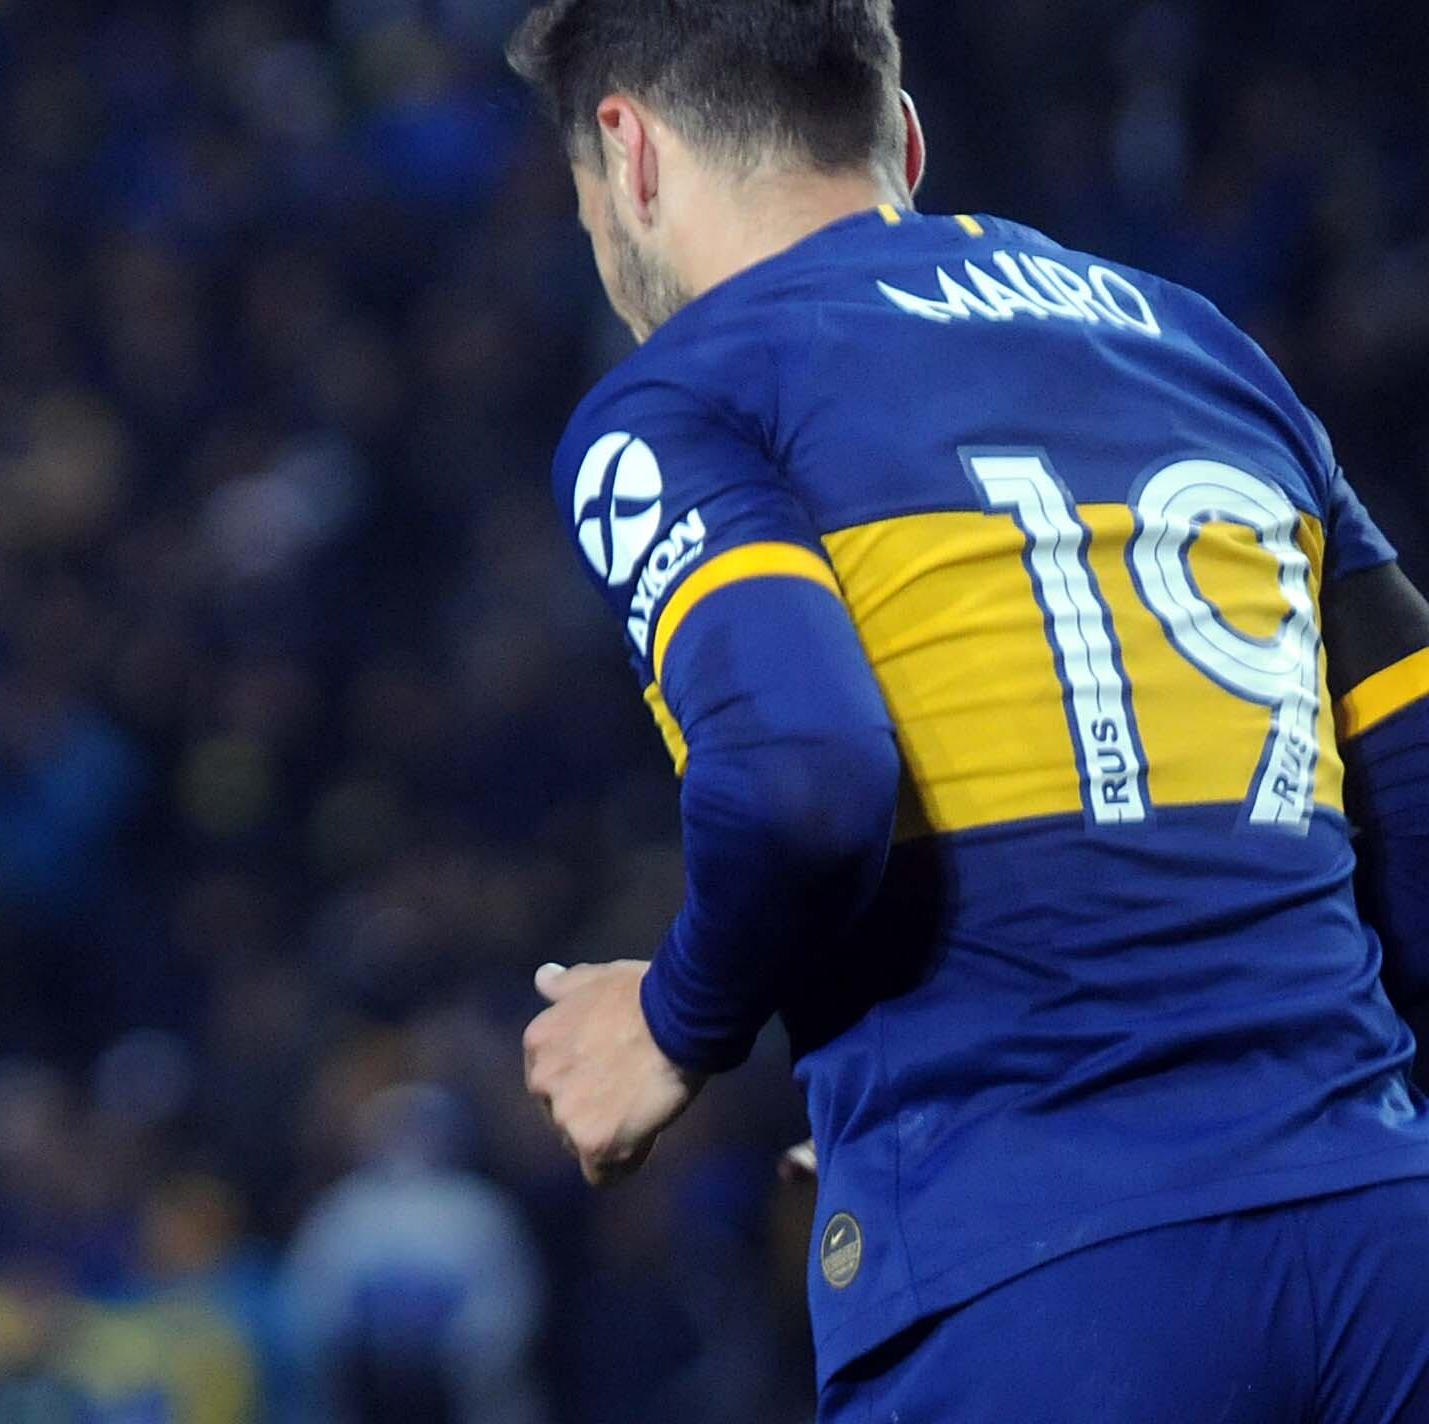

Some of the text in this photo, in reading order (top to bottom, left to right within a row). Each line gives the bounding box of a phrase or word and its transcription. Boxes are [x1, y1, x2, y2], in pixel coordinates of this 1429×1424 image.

[876, 250, 1162, 338] MAURO
[627, 507, 706, 657] AXION
[970, 456, 1319, 834] 19
[1091, 716, 1130, 806] RUS
